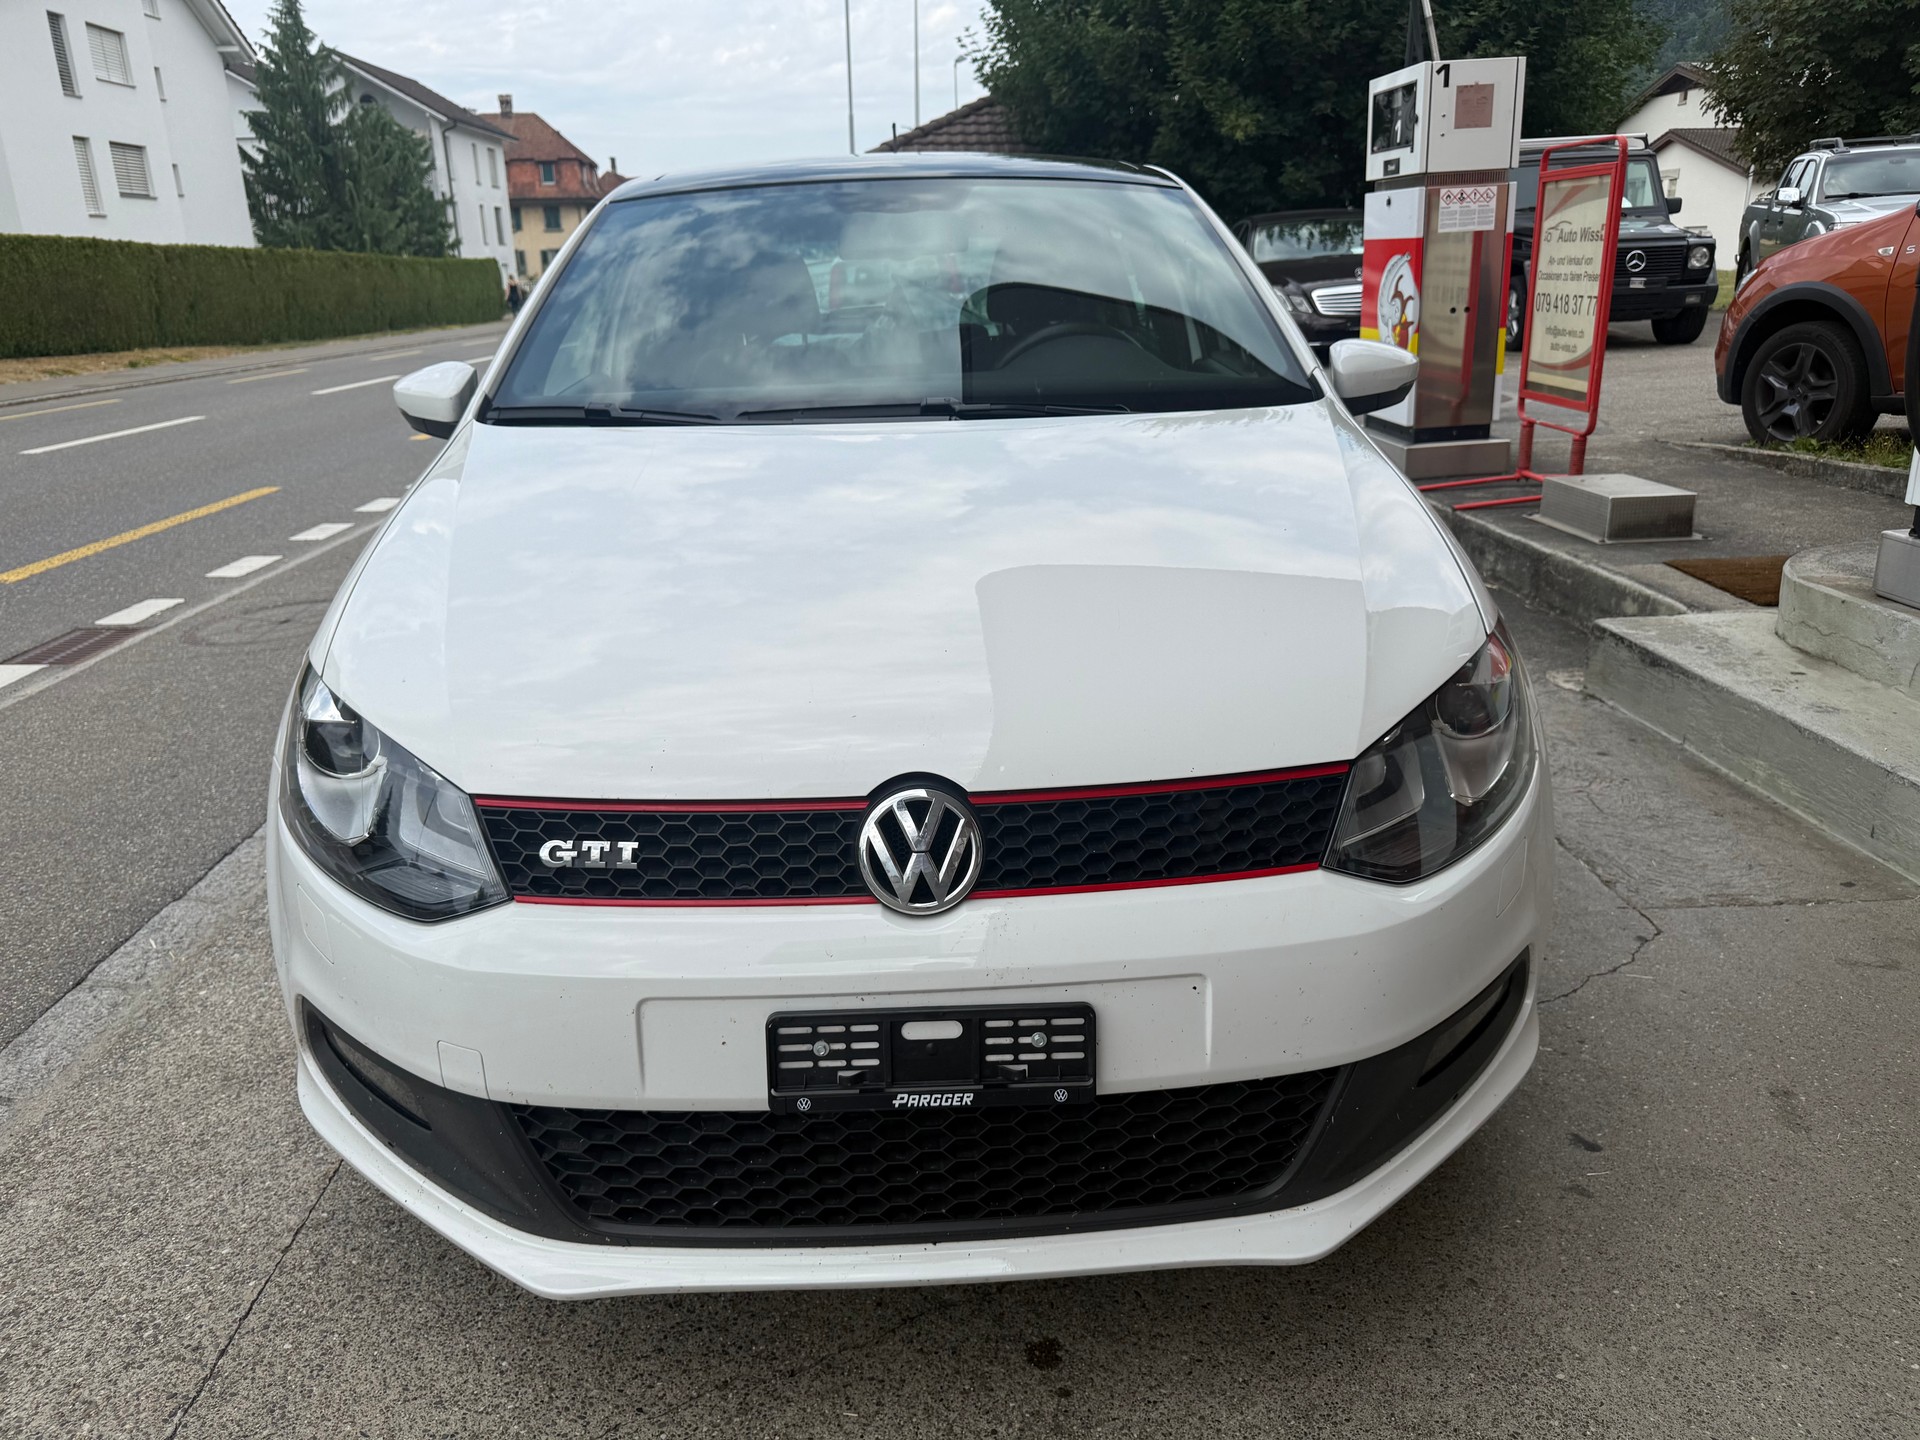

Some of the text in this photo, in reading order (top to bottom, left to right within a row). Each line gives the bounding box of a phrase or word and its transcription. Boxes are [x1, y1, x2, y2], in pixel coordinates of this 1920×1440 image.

[1435, 64, 1450, 88] 1
[1395, 119, 1402, 144] 1
[1557, 227, 1578, 243] Auto
[1535, 291, 1599, 316] 079 418 37 77
[539, 839, 640, 869] GTI
[892, 1092, 974, 1108] PARGGER
